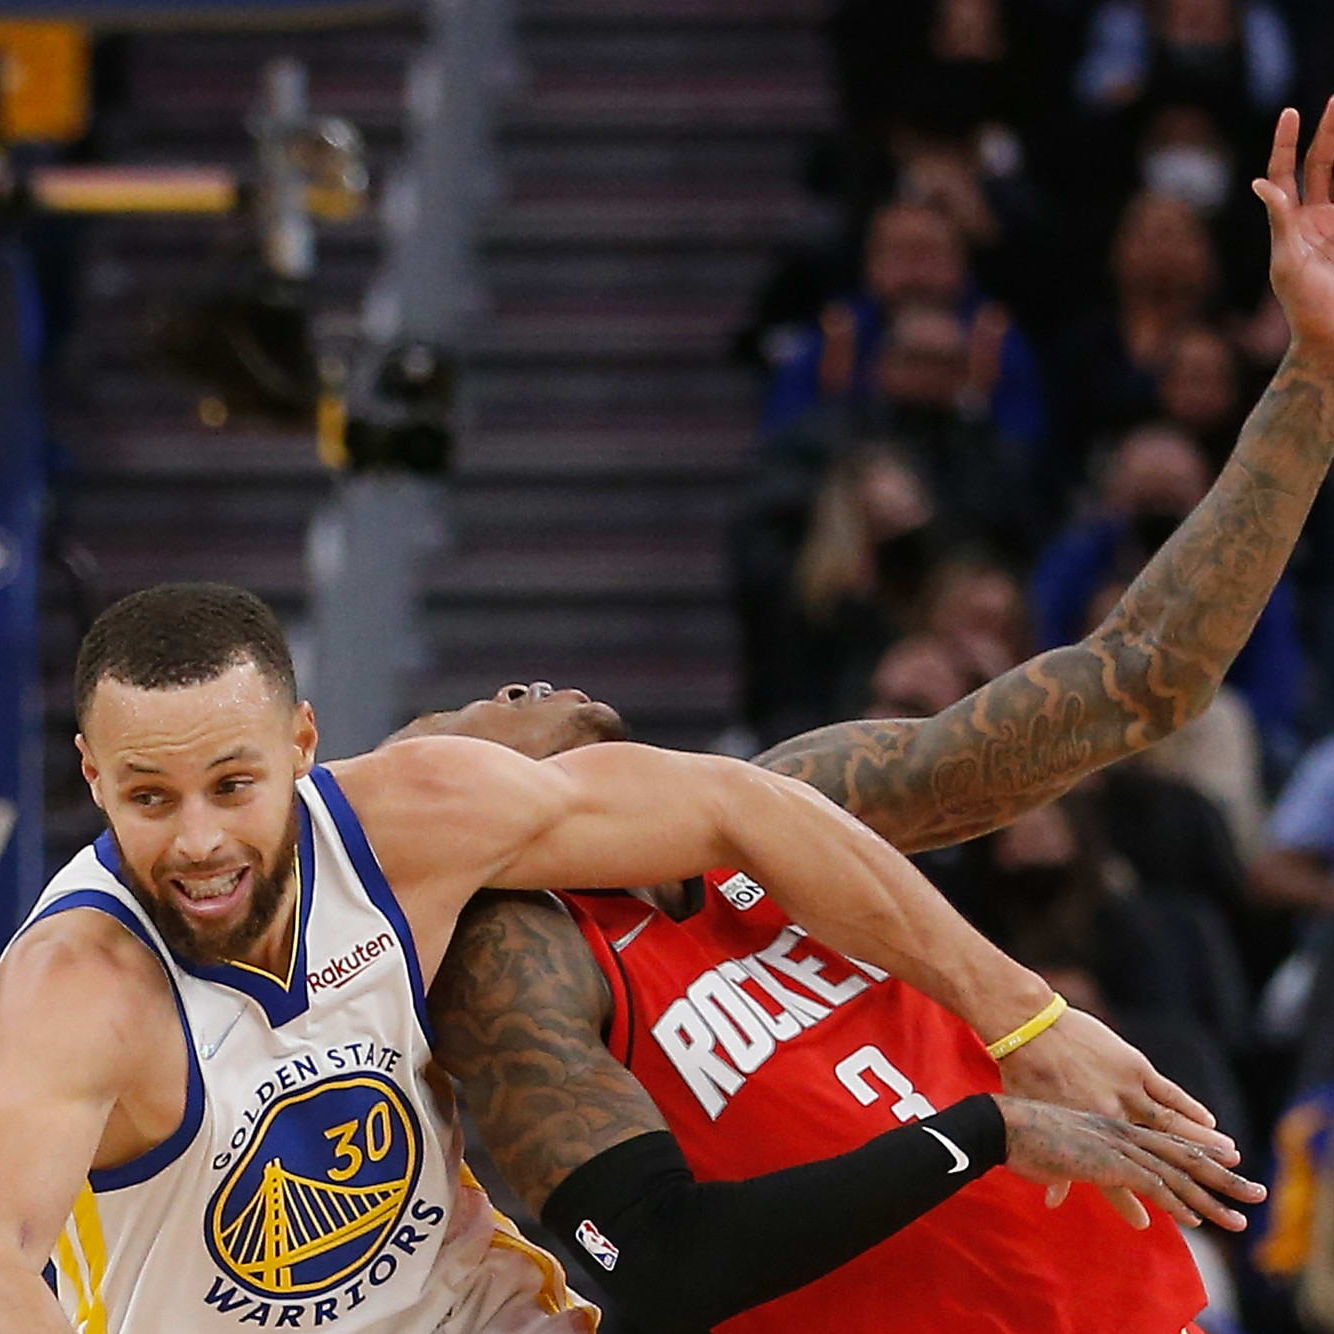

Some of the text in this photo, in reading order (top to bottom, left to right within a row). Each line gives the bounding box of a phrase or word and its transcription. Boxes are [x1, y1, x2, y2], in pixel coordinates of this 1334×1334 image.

[307, 932, 395, 993] Rakuten
[650, 924, 893, 1122] ROCKE
[212, 1042, 402, 1171] GOLDEN STATE
[323, 1101, 392, 1182] 30
[204, 1199, 446, 1328] WARRIORS
